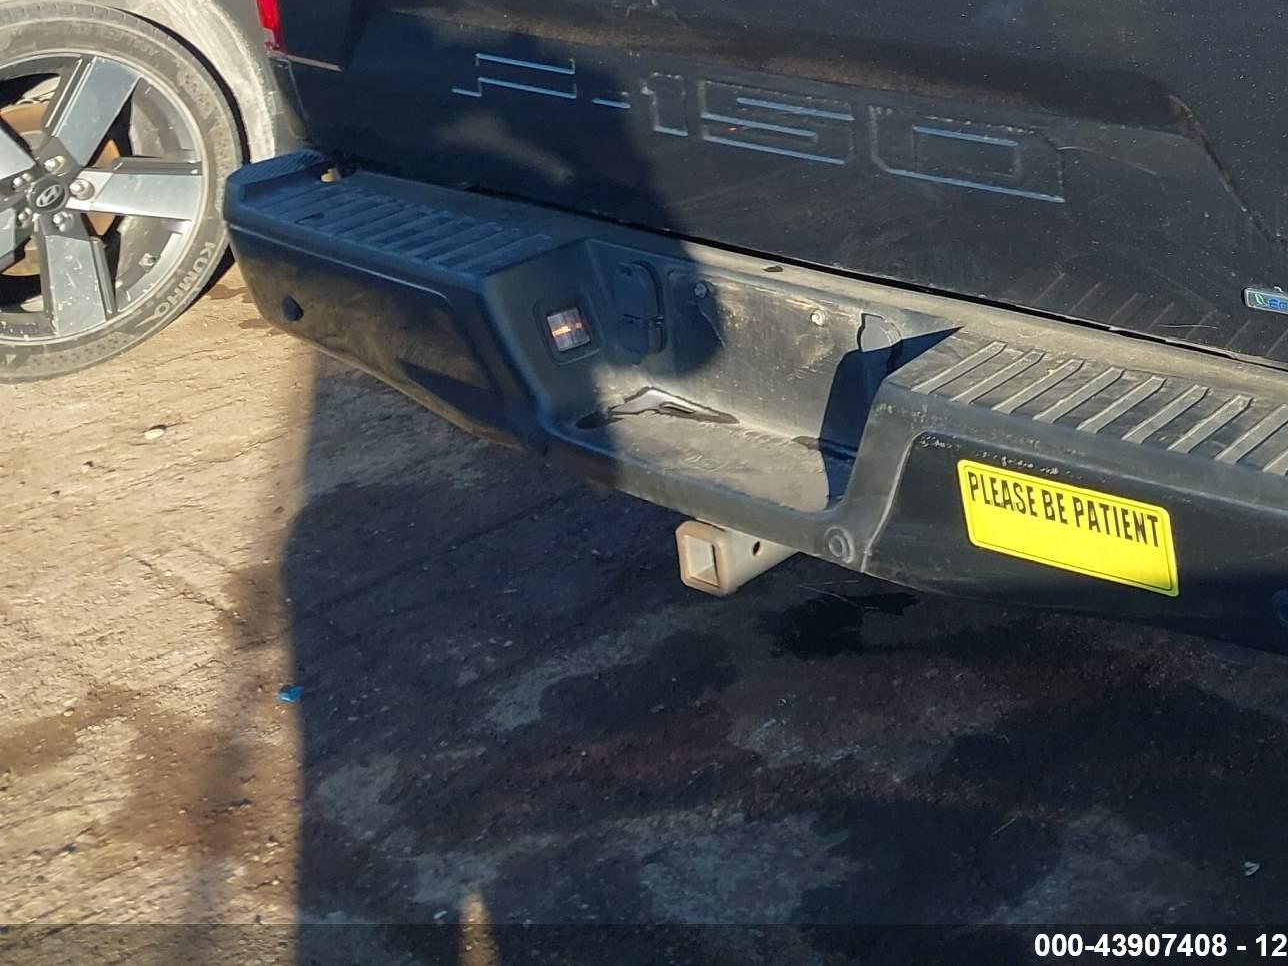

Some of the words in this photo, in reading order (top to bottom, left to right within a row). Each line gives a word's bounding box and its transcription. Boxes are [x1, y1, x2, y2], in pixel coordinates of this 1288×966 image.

[448, 37, 1066, 202] F-150
[154, 241, 217, 317] KUMHO
[967, 471, 1038, 517] PLEASE
[1041, 488, 1068, 525] BE
[1072, 497, 1160, 548] PATIENT
